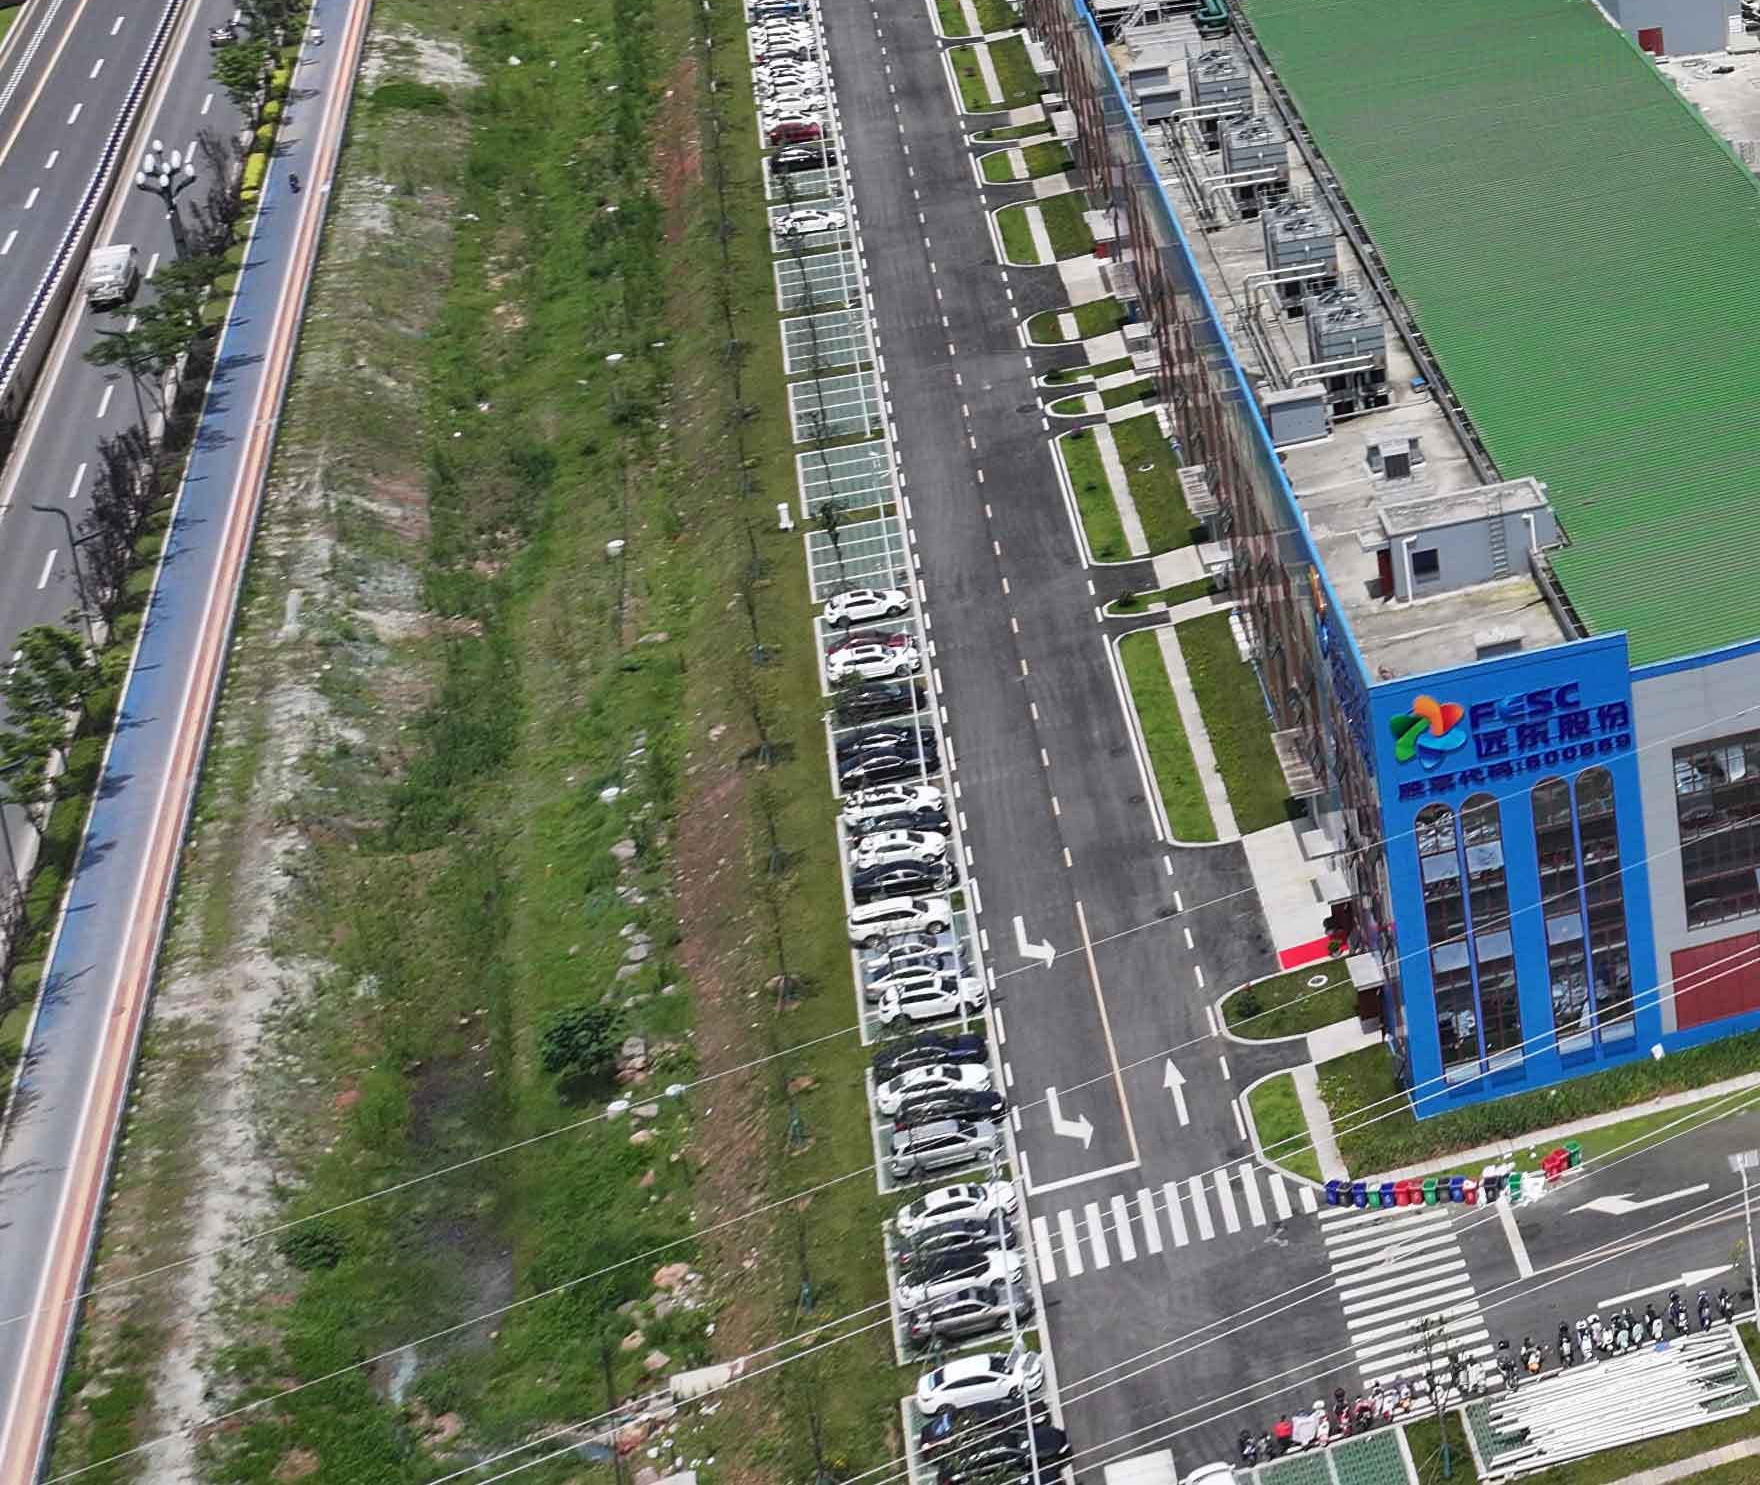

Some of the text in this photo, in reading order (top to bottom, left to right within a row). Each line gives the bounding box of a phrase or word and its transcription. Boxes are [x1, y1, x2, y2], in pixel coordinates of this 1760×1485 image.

[1470, 682, 1580, 728] FESC
[1475, 700, 1629, 761] 远东股份
